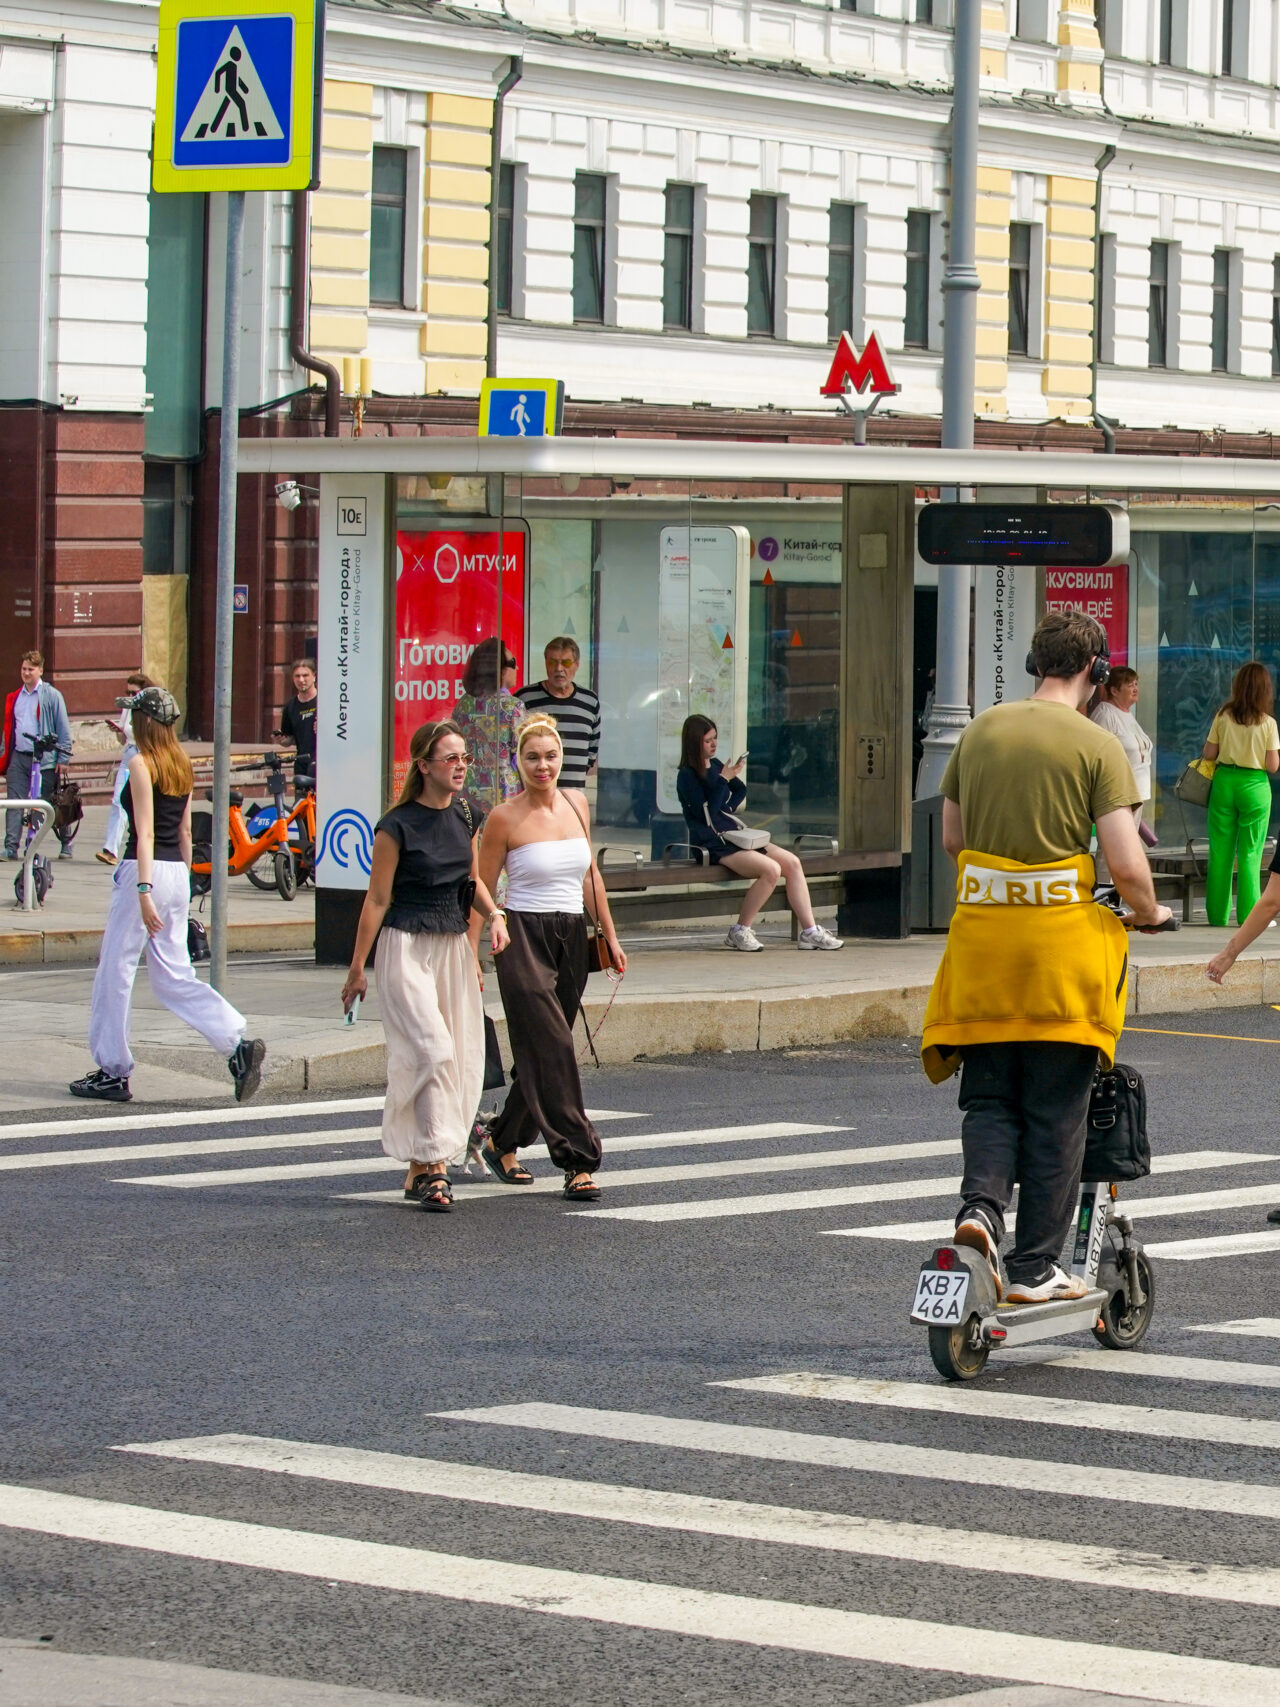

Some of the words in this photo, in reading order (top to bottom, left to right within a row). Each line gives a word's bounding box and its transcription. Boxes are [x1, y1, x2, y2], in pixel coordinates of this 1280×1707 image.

[463, 555, 516, 572] МТУСИ
[764, 542, 774, 556] 7
[353, 549, 362, 616] Kitay-Gorod
[1007, 565, 1016, 609] Kitay-Go
[337, 547, 351, 677] «Китай-город»
[1087, 597, 1113, 618] ВСЁ
[352, 620, 361, 654] Metro
[400, 638, 479, 666] Готови
[993, 665, 1005, 706] етро
[337, 682, 349, 740] Метро
[1089, 1204, 1107, 1277] KB746A
[920, 1275, 966, 1296] KB7
[917, 1298, 959, 1319] 46A
